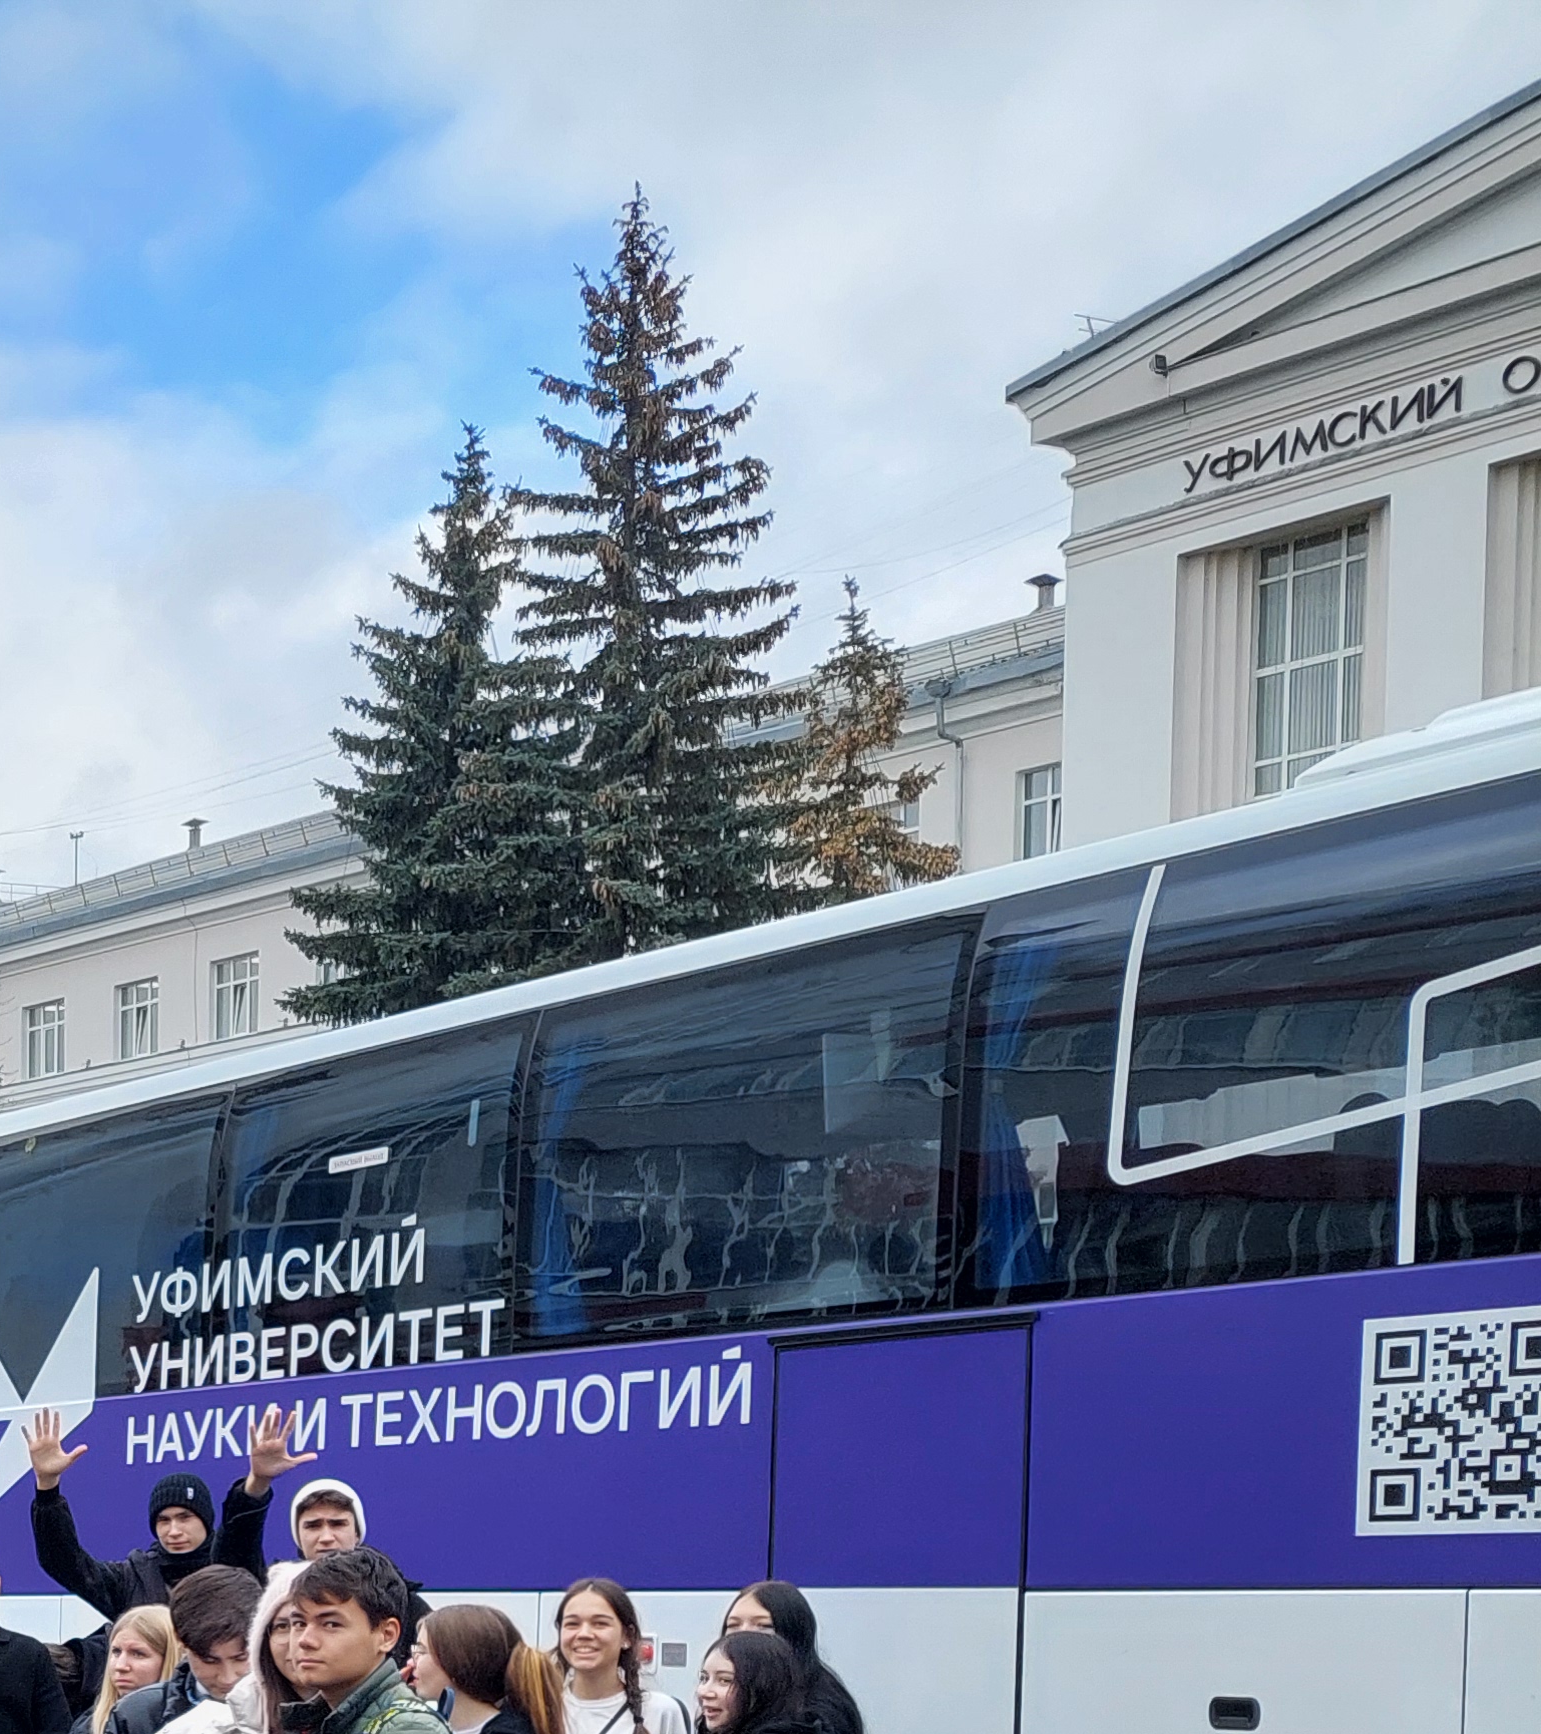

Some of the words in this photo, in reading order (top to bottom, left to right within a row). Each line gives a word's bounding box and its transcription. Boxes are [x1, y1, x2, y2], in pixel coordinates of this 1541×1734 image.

[1182, 375, 1463, 494] УФИМСКИЙ
[132, 1213, 426, 1324] УФИМСКИЙ
[129, 1298, 506, 1394] УНИВЕРСИТЕТ
[294, 1397, 327, 1453] И
[340, 1345, 753, 1449] ТЕХНОЛОГИЙ
